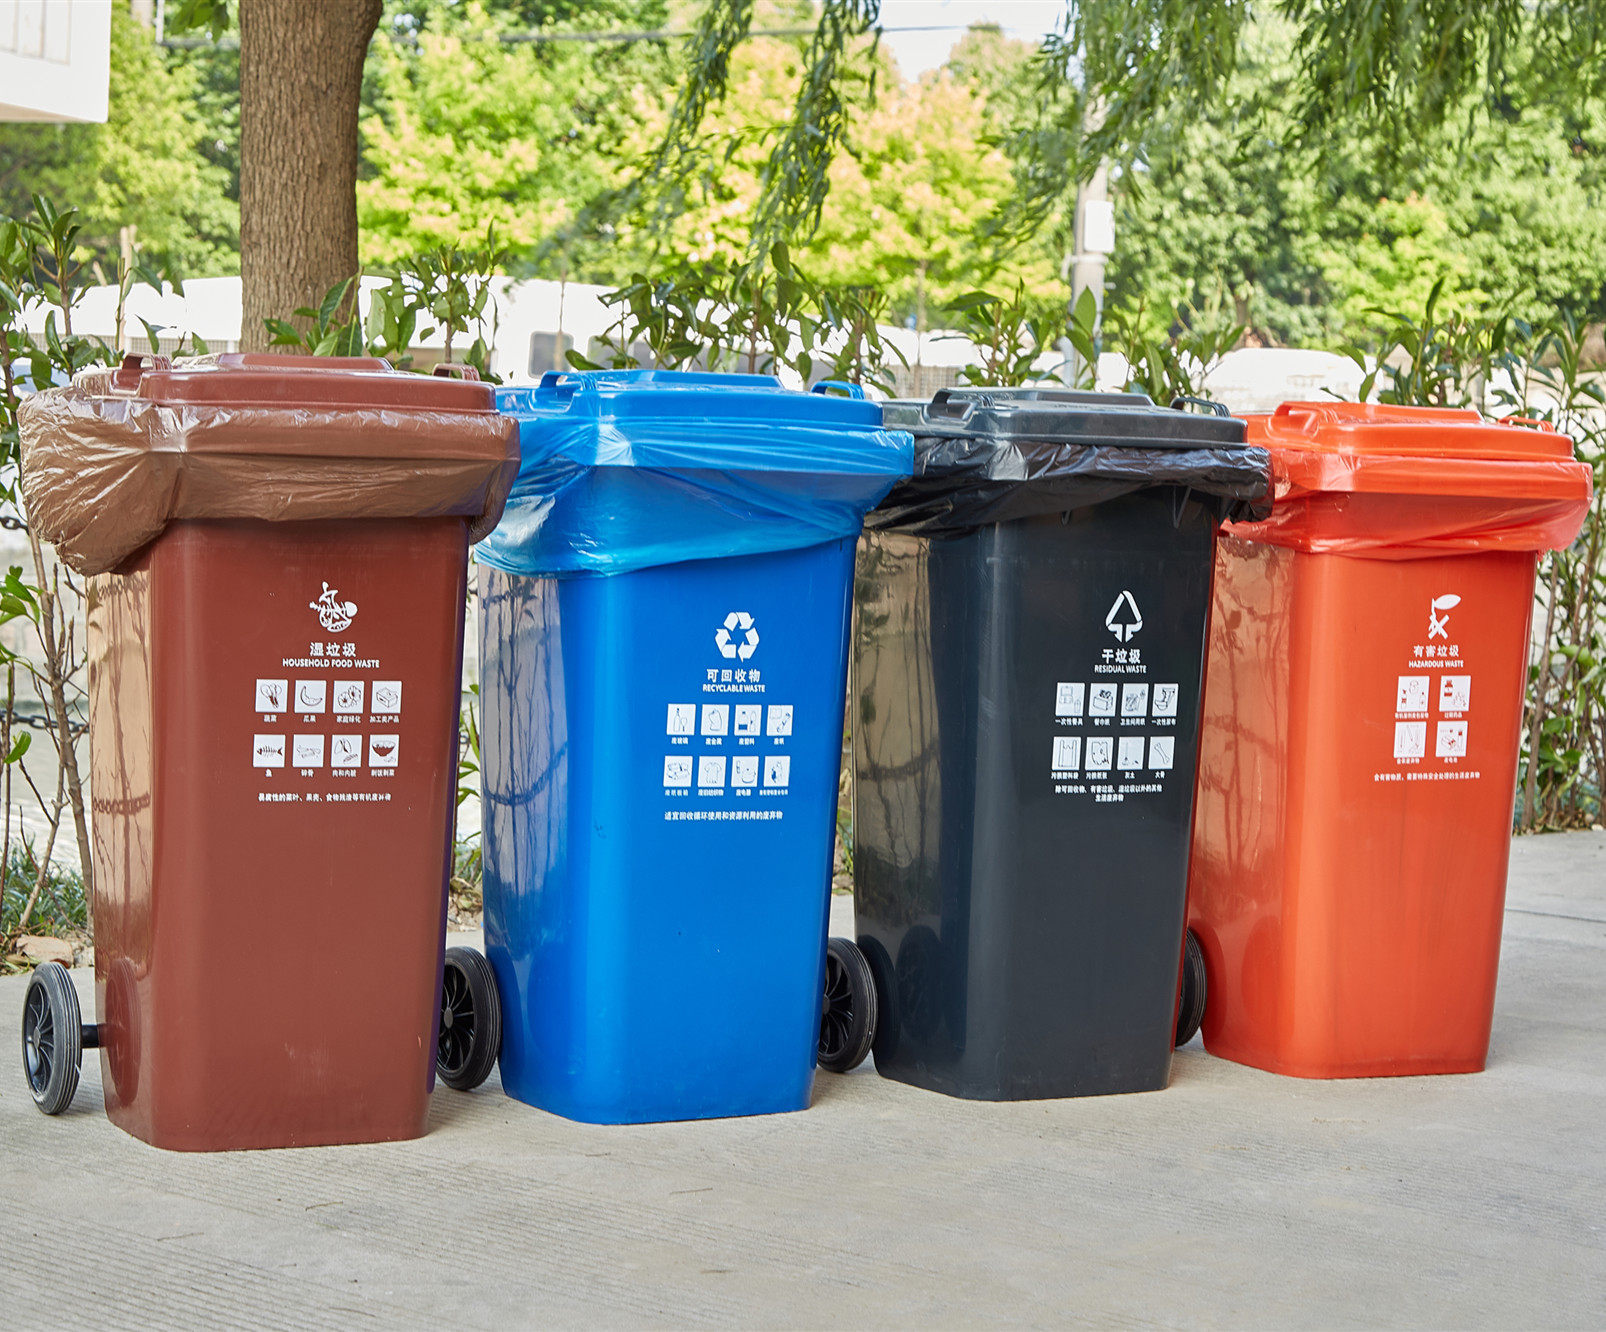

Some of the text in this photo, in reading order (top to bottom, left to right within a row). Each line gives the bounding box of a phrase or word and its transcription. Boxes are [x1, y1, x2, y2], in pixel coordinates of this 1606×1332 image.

[310, 642, 356, 657] 湿垃圾
[1414, 645, 1459, 657] 有害垃圾
[1102, 649, 1140, 664] 干垃圾
[283, 658, 379, 668] HOUSEHOLD FOOD WASTE
[1409, 660, 1444, 668] HAZARDOUS
[1095, 665, 1146, 673] RESIDUAL WASTE
[707, 669, 760, 683] 可回收物
[703, 684, 743, 692] RECYCLABLE
